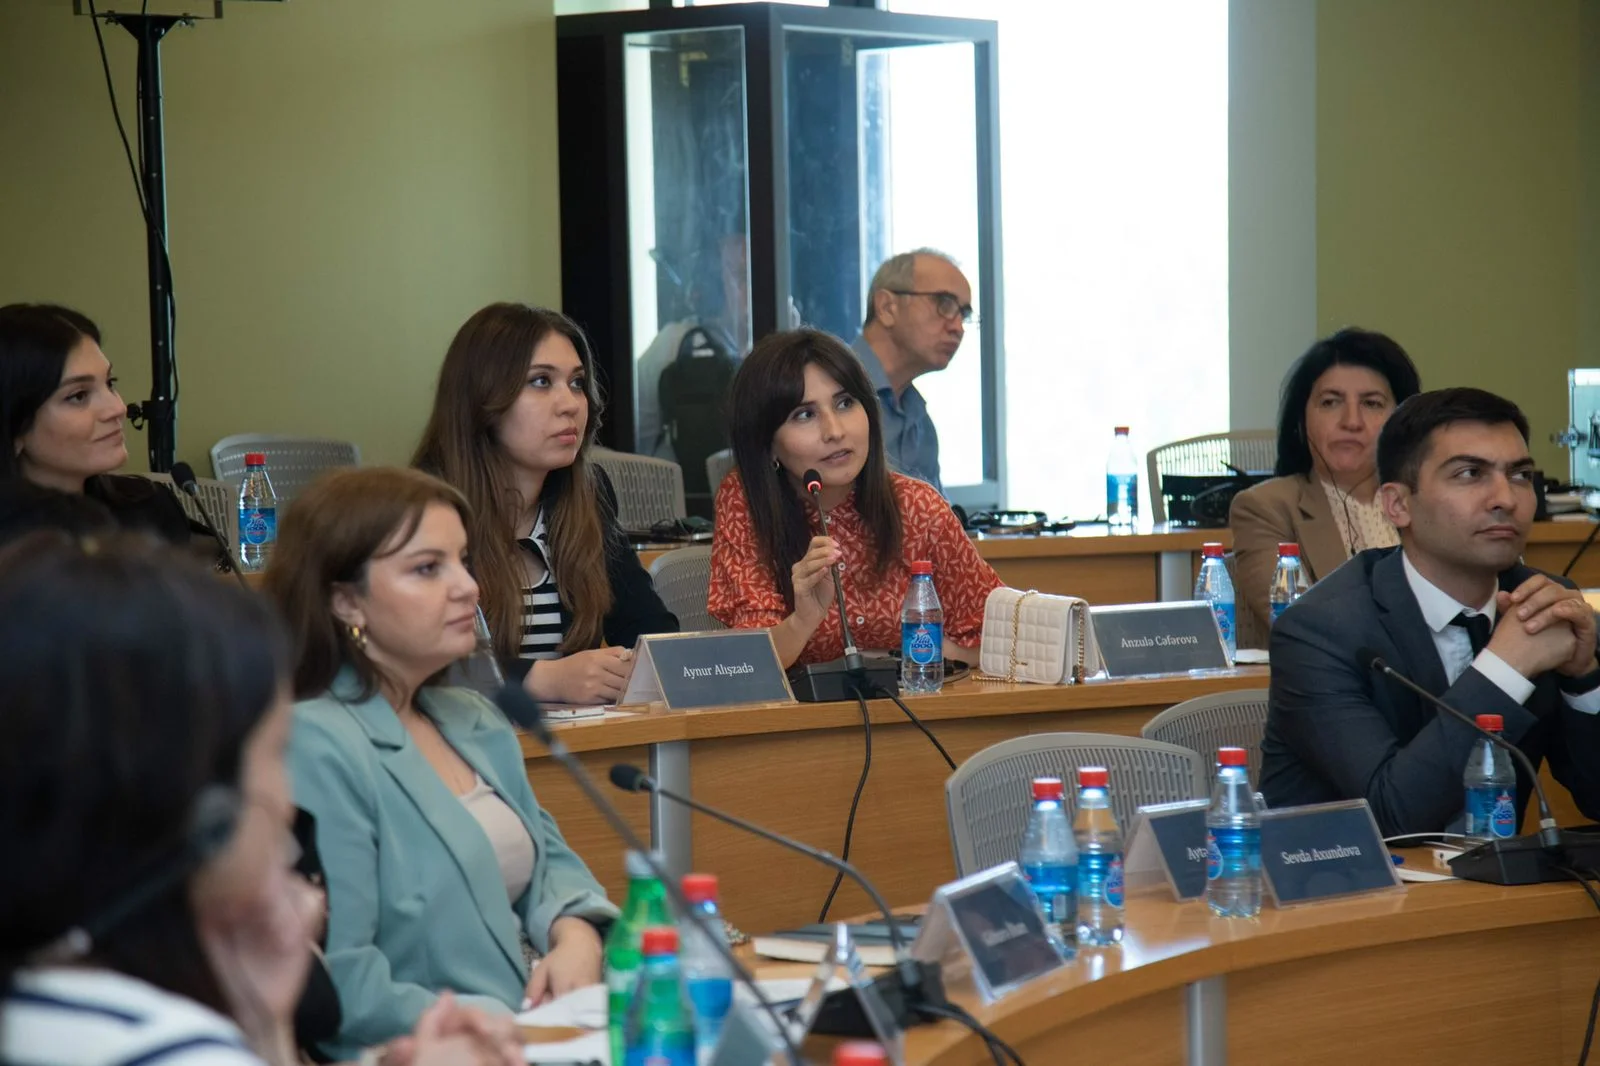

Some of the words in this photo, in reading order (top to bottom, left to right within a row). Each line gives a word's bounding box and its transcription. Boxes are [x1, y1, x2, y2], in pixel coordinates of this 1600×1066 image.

[683, 665, 712, 680] Aynur
[714, 662, 754, 677] Alışzadə
[1281, 848, 1312, 865] Sevda
[1312, 844, 1362, 861] Axundova
